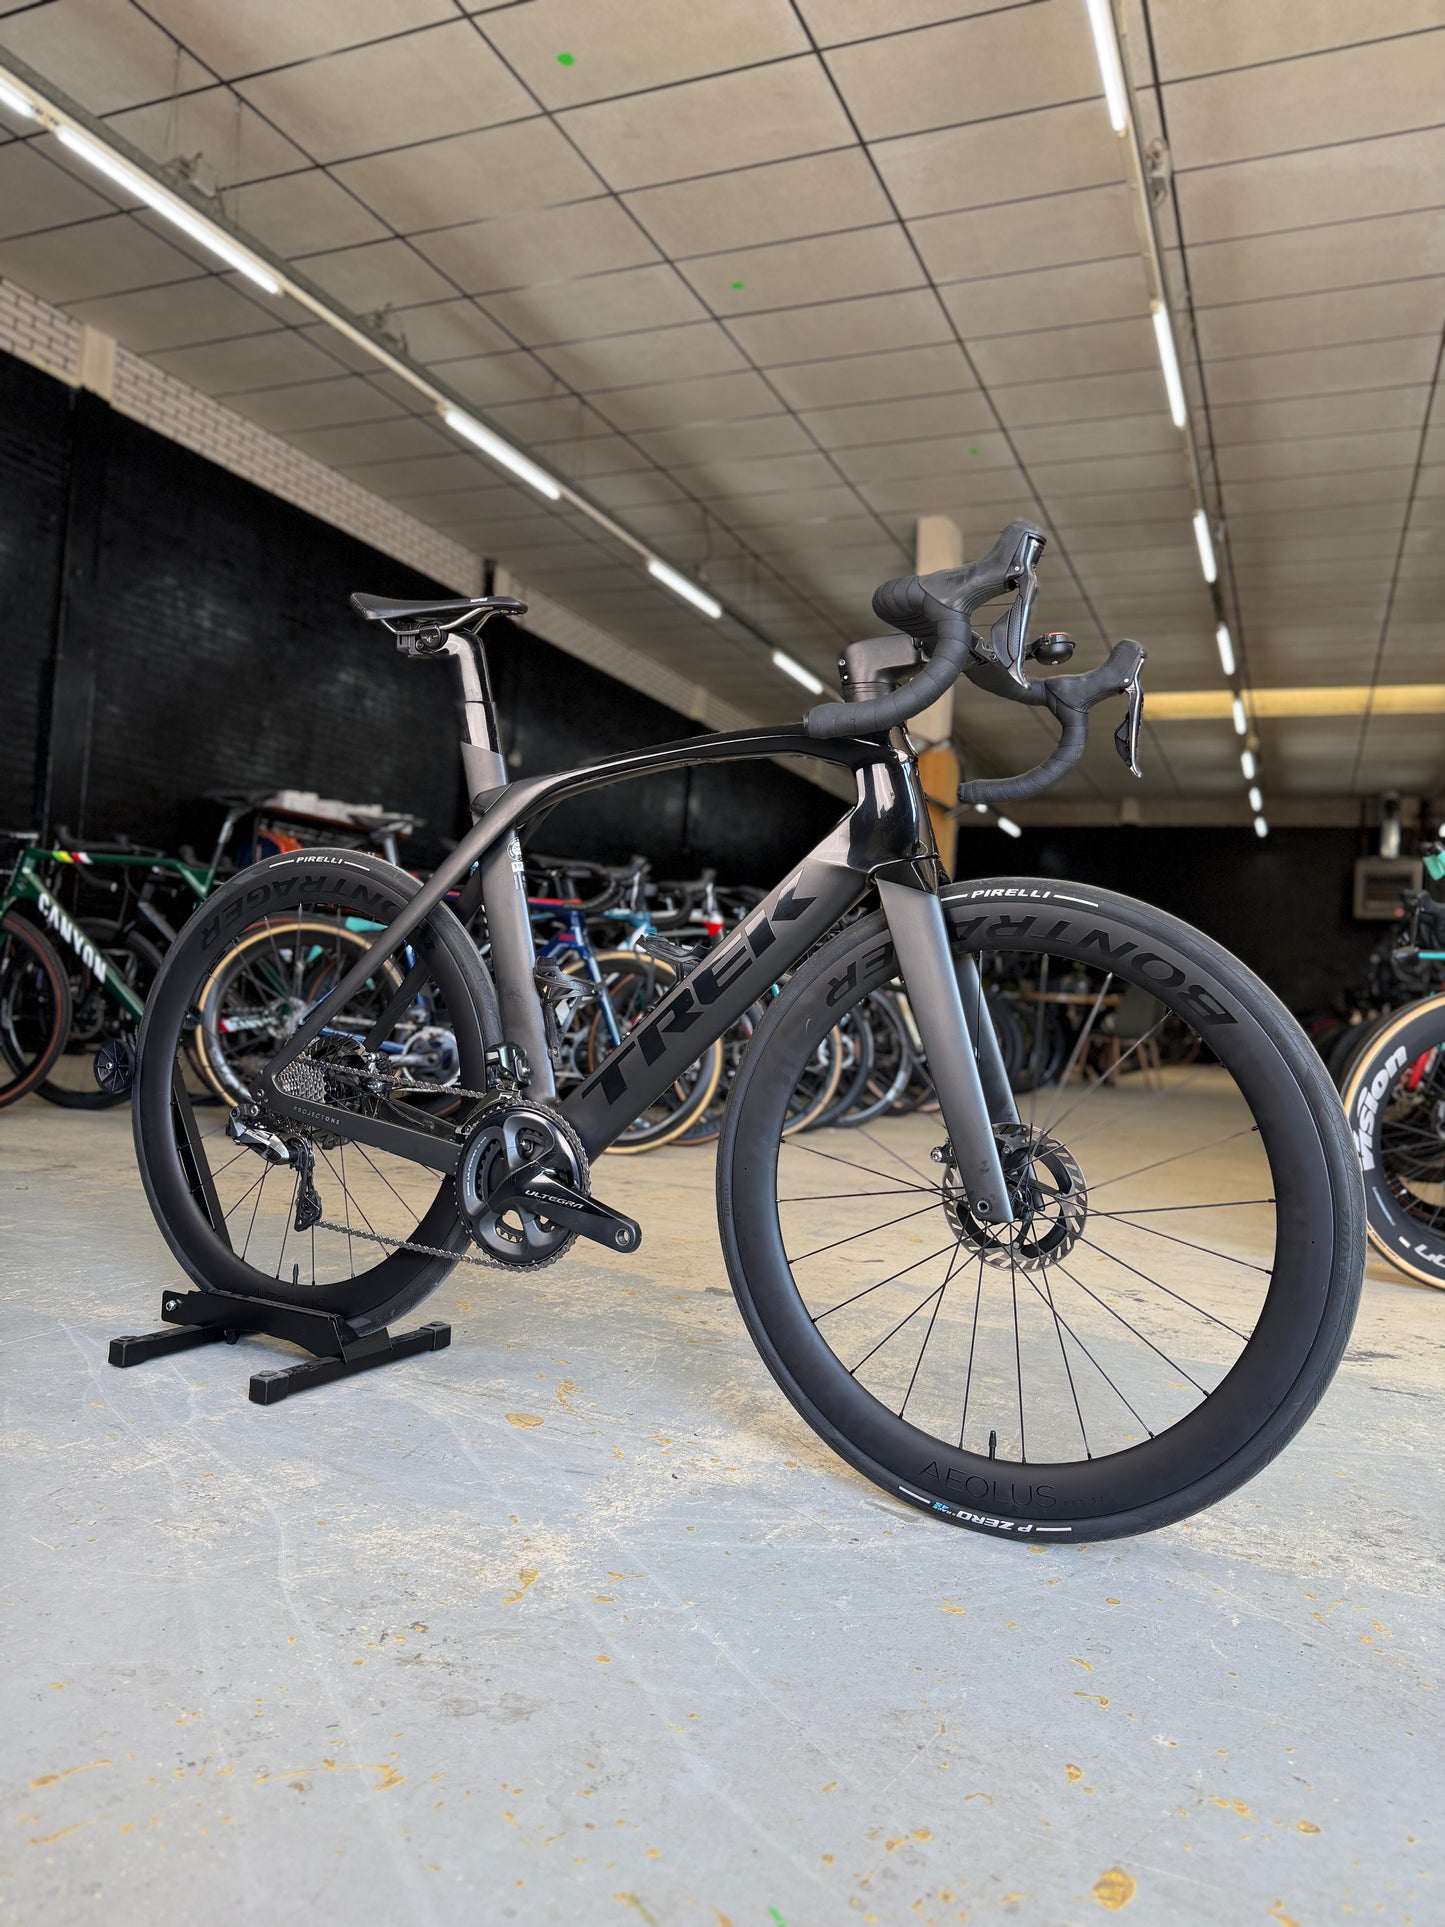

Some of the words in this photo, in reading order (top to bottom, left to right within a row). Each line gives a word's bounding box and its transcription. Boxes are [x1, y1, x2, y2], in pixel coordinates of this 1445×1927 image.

[296, 856, 343, 864] PIRELLI
[971, 888, 1051, 899] PIRELLI
[38, 892, 107, 984] CANYON
[826, 914, 1239, 1026] BONTRAER
[581, 868, 818, 1105] TREK
[525, 1189, 584, 1210] ULTEGRA
[919, 1460, 1057, 1508] AEOLUS
[956, 1510, 1015, 1531] ZERO
[1017, 1523, 1033, 1533] P
